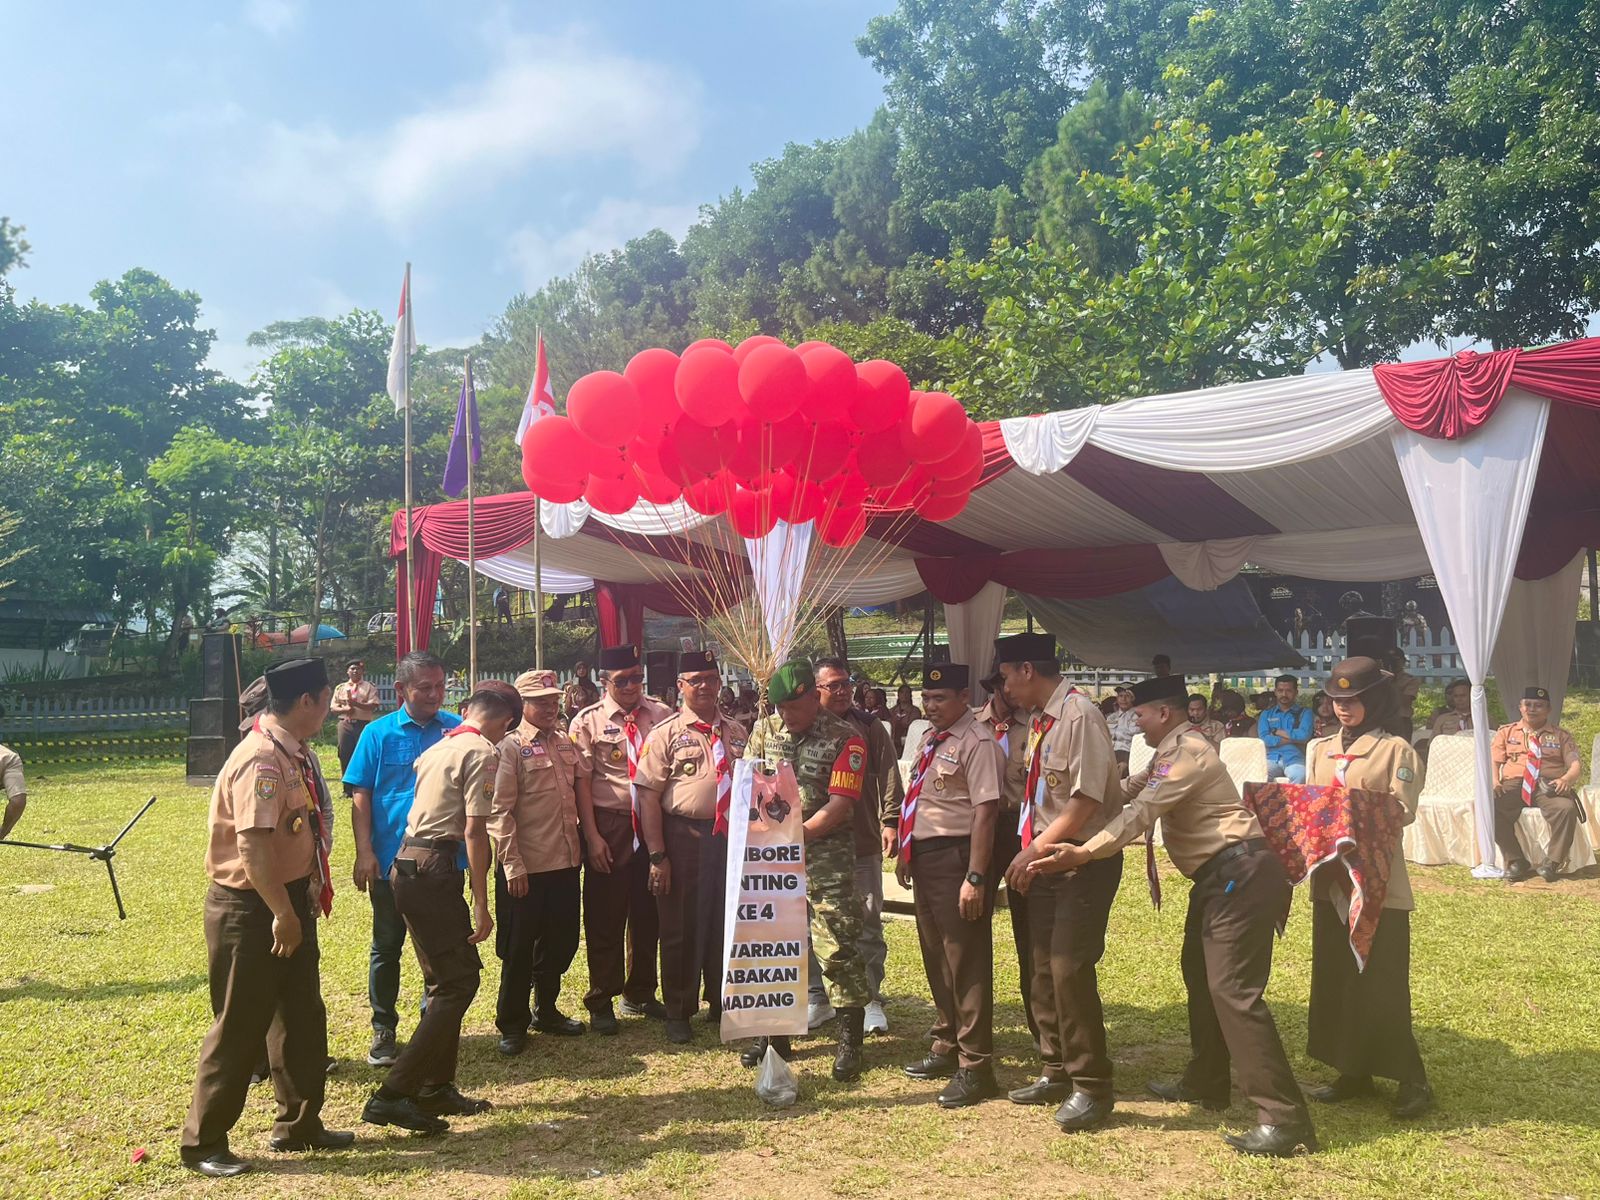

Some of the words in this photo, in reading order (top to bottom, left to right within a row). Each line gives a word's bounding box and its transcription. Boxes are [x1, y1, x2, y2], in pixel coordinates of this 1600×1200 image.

[807, 749, 818, 758] TNI
[821, 752, 833, 761] AD
[744, 845, 800, 862] BORE
[741, 874, 798, 891] NTING
[760, 903, 774, 920] 4
[726, 967, 798, 985] ABAKAN
